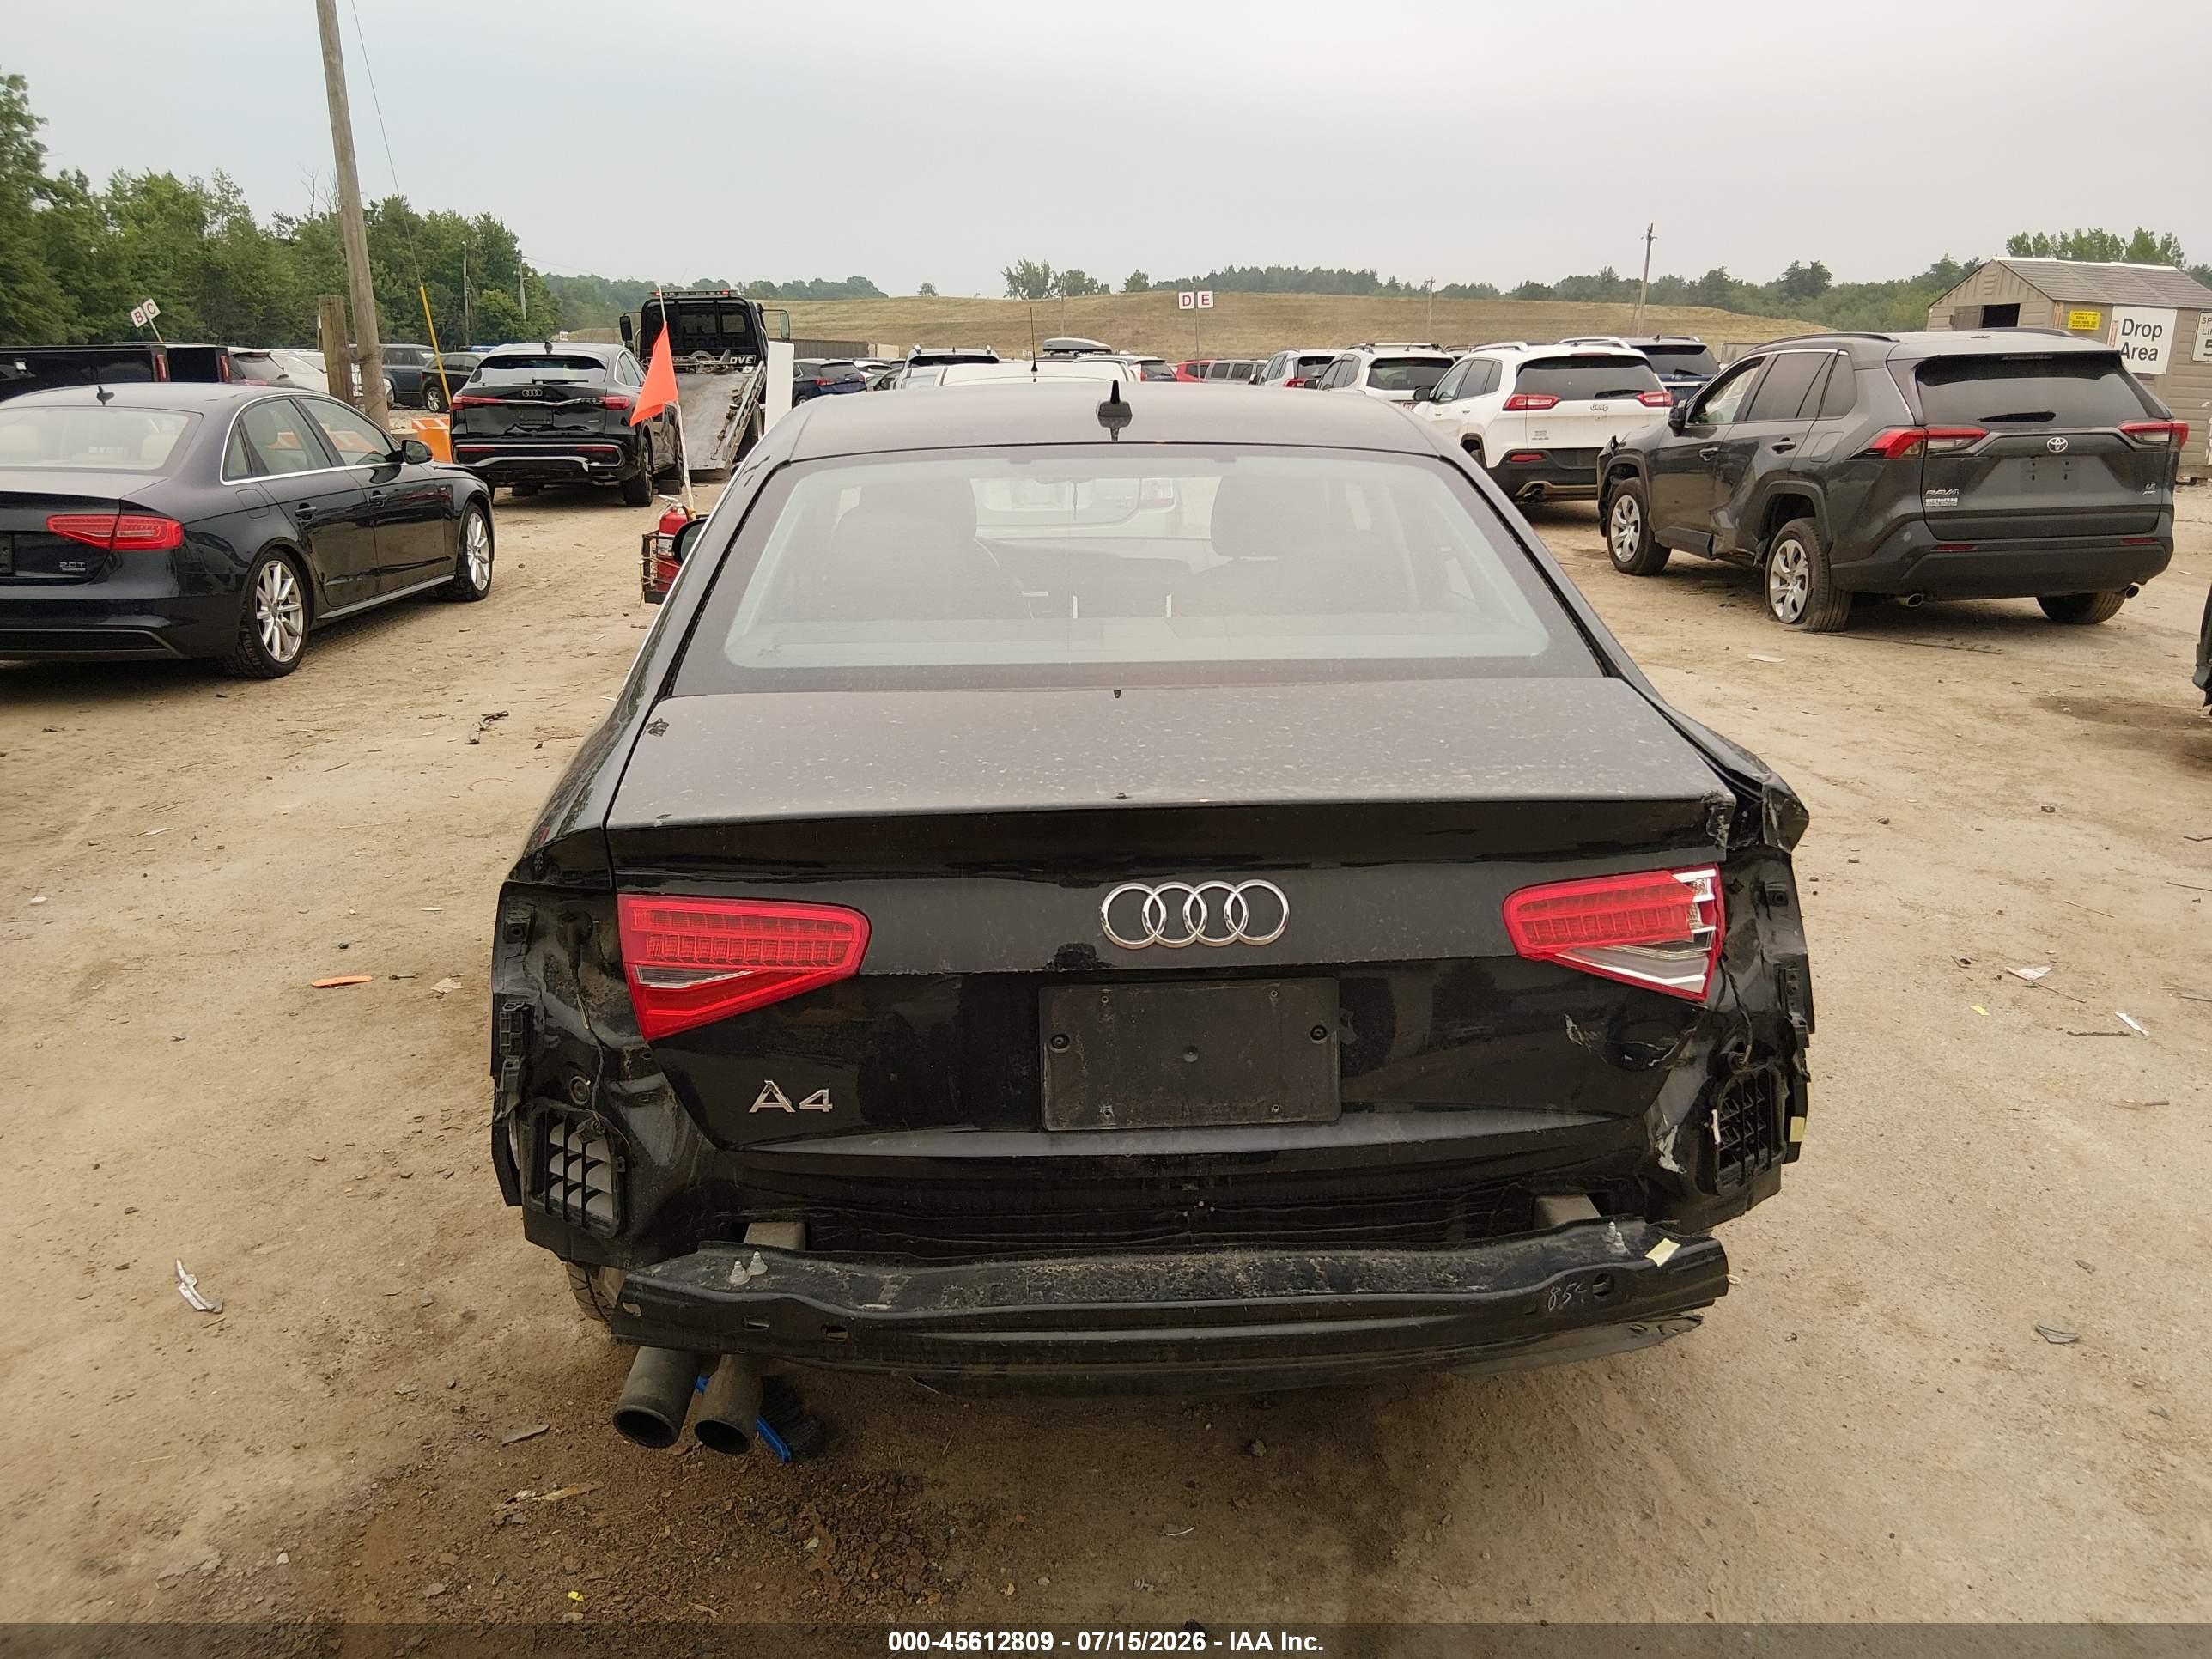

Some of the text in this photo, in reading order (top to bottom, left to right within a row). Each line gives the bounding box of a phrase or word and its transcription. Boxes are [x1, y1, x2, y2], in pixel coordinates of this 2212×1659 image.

[1182, 295, 1192, 307] D
[1201, 294, 1210, 306] E
[146, 302, 156, 315] C
[134, 311, 143, 324] B
[2121, 318, 2163, 341] Drop
[2120, 342, 2159, 361] Area
[749, 1080, 833, 1113] A4
